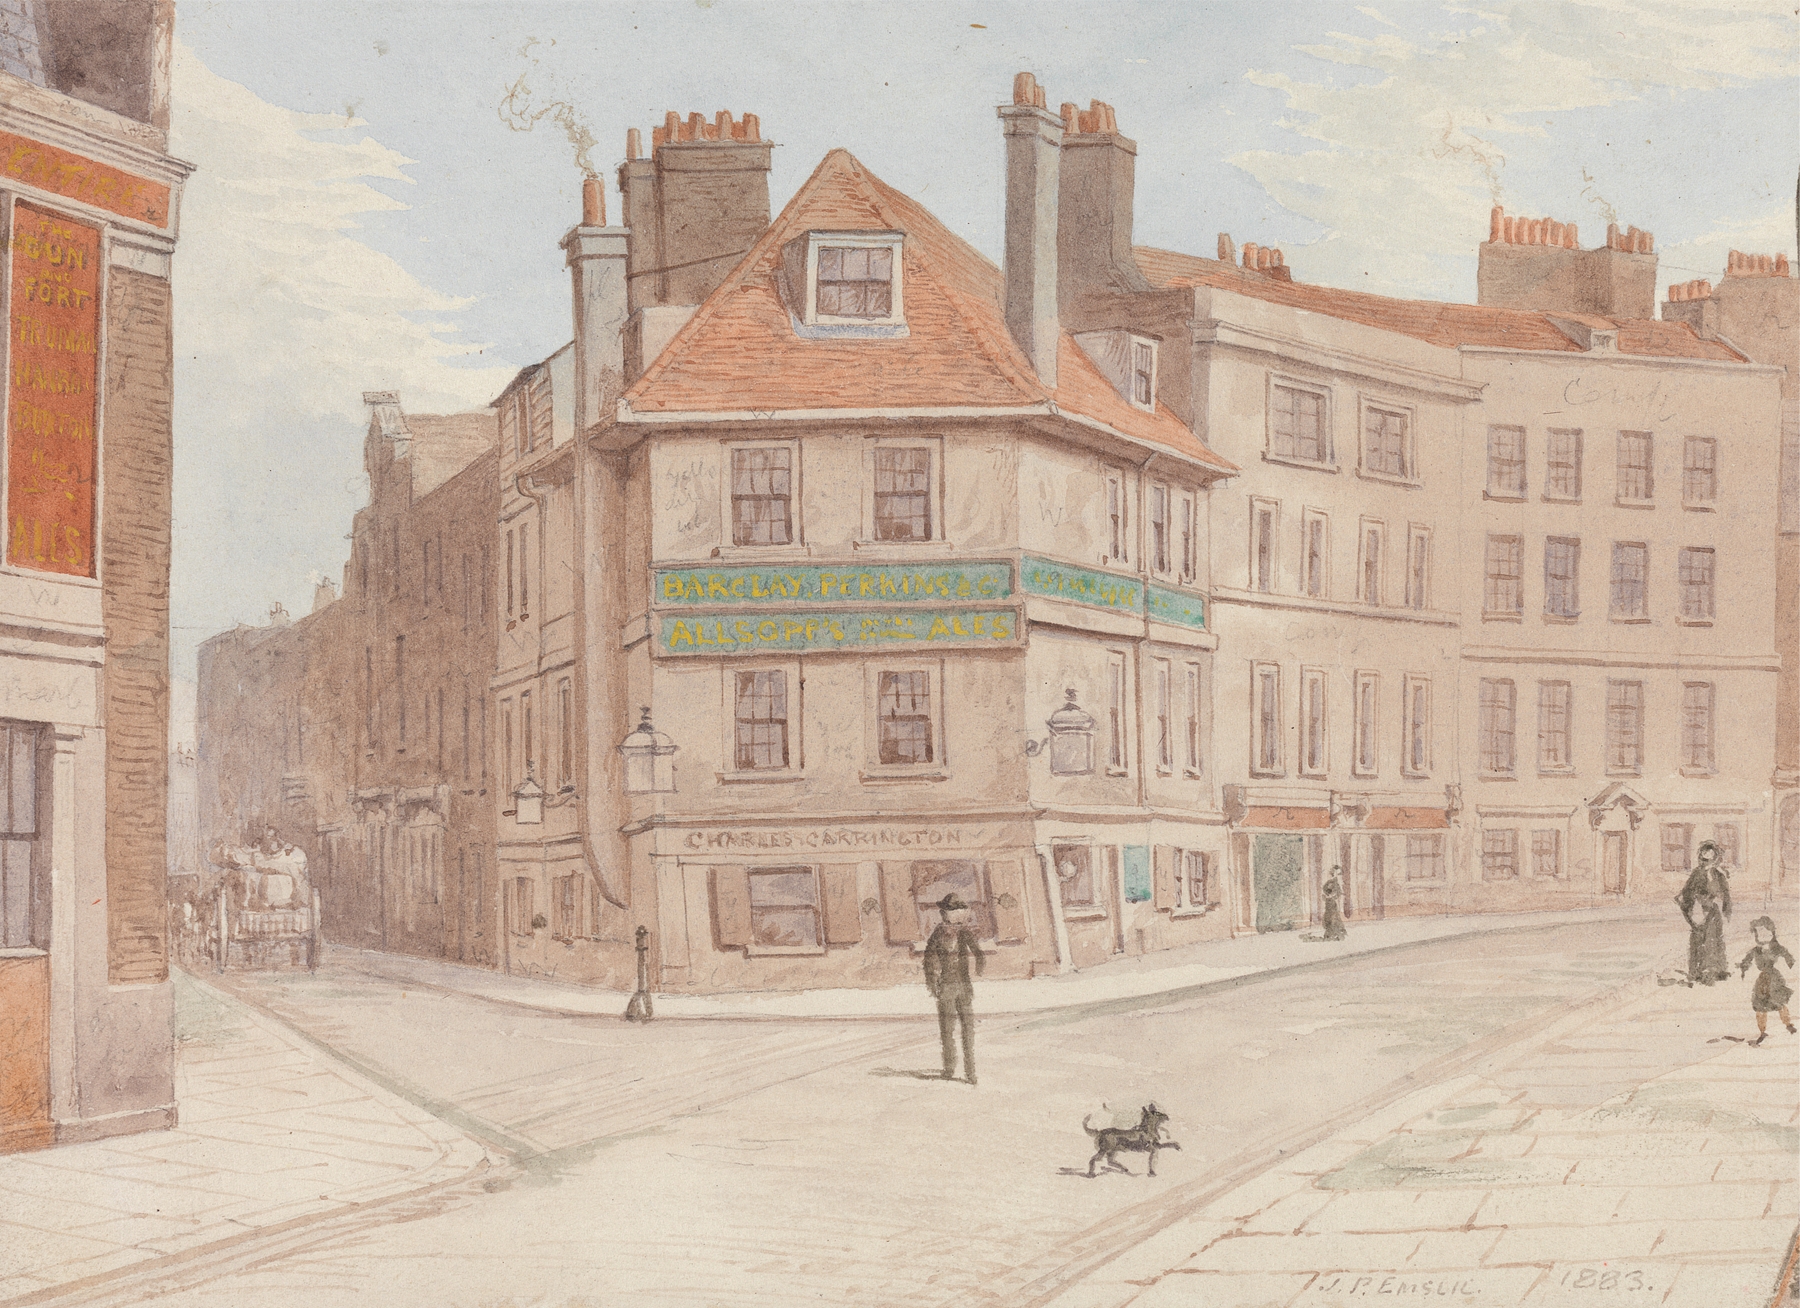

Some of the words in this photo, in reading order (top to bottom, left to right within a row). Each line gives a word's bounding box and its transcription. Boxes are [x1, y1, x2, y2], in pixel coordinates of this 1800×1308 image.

[25, 277, 90, 308] FORT
[11, 512, 84, 565] ALES
[819, 572, 950, 597] PERKINS
[669, 616, 845, 648] ALLSOPP'S
[926, 614, 1011, 641] ALES
[684, 830, 794, 850] CHARLES
[805, 828, 961, 848] CARRINGTON
